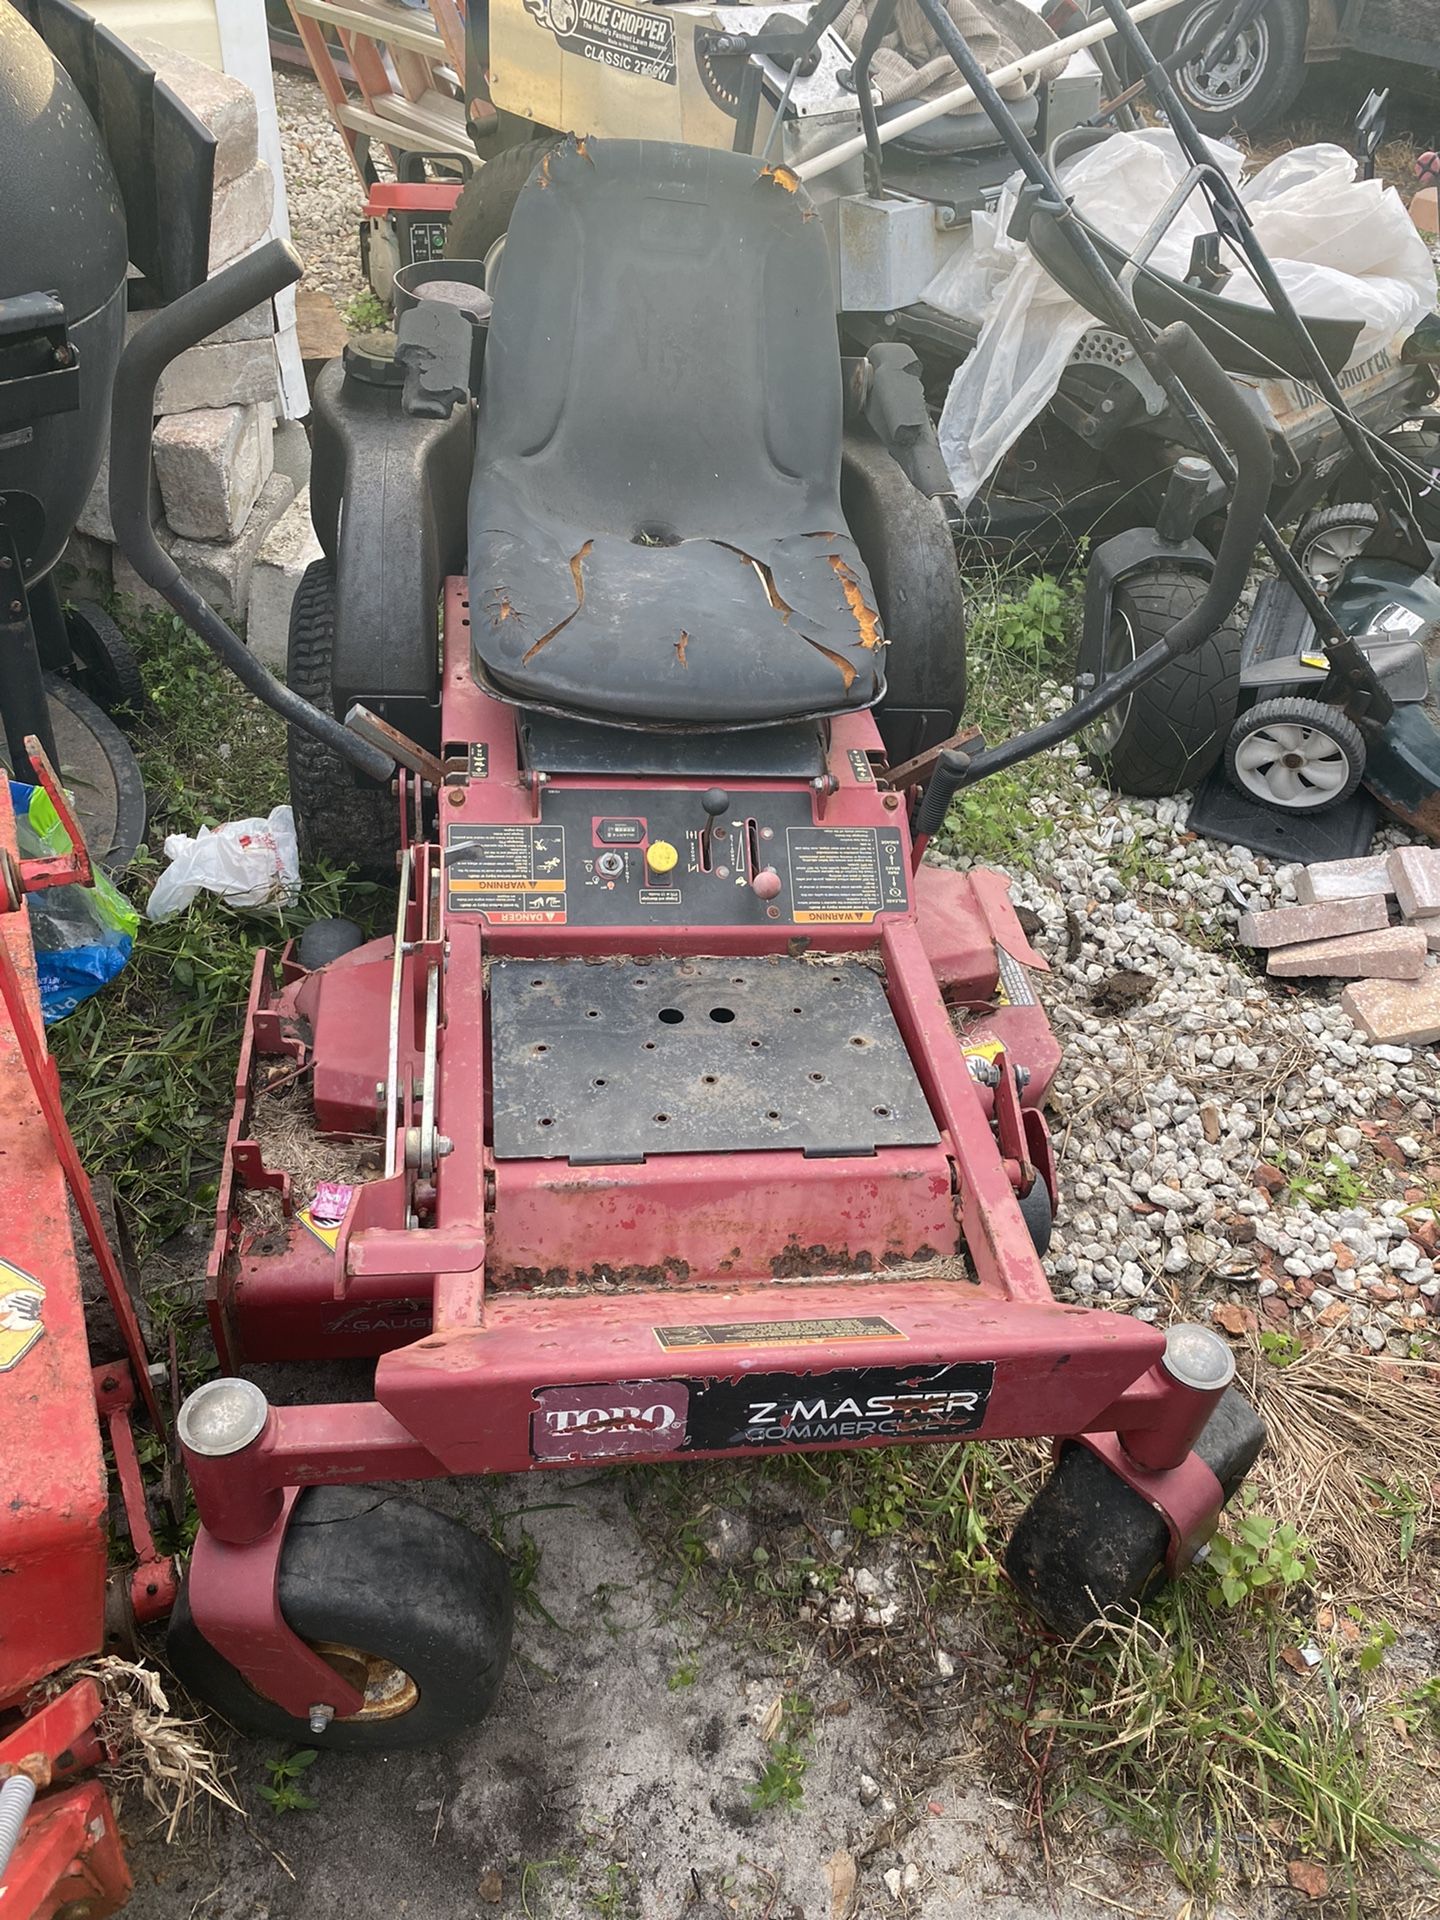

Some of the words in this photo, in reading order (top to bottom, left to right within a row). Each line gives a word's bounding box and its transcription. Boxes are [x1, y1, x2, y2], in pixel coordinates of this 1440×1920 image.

[579, 0, 612, 26] DIXIE
[611, 9, 667, 42] CHOPPER
[584, 44, 633, 71] CLASSIC
[479, 881, 526, 889] WARNING
[501, 913, 543, 921] DANGER
[809, 912, 853, 921] WARNING
[546, 1403, 677, 1438] TORO
